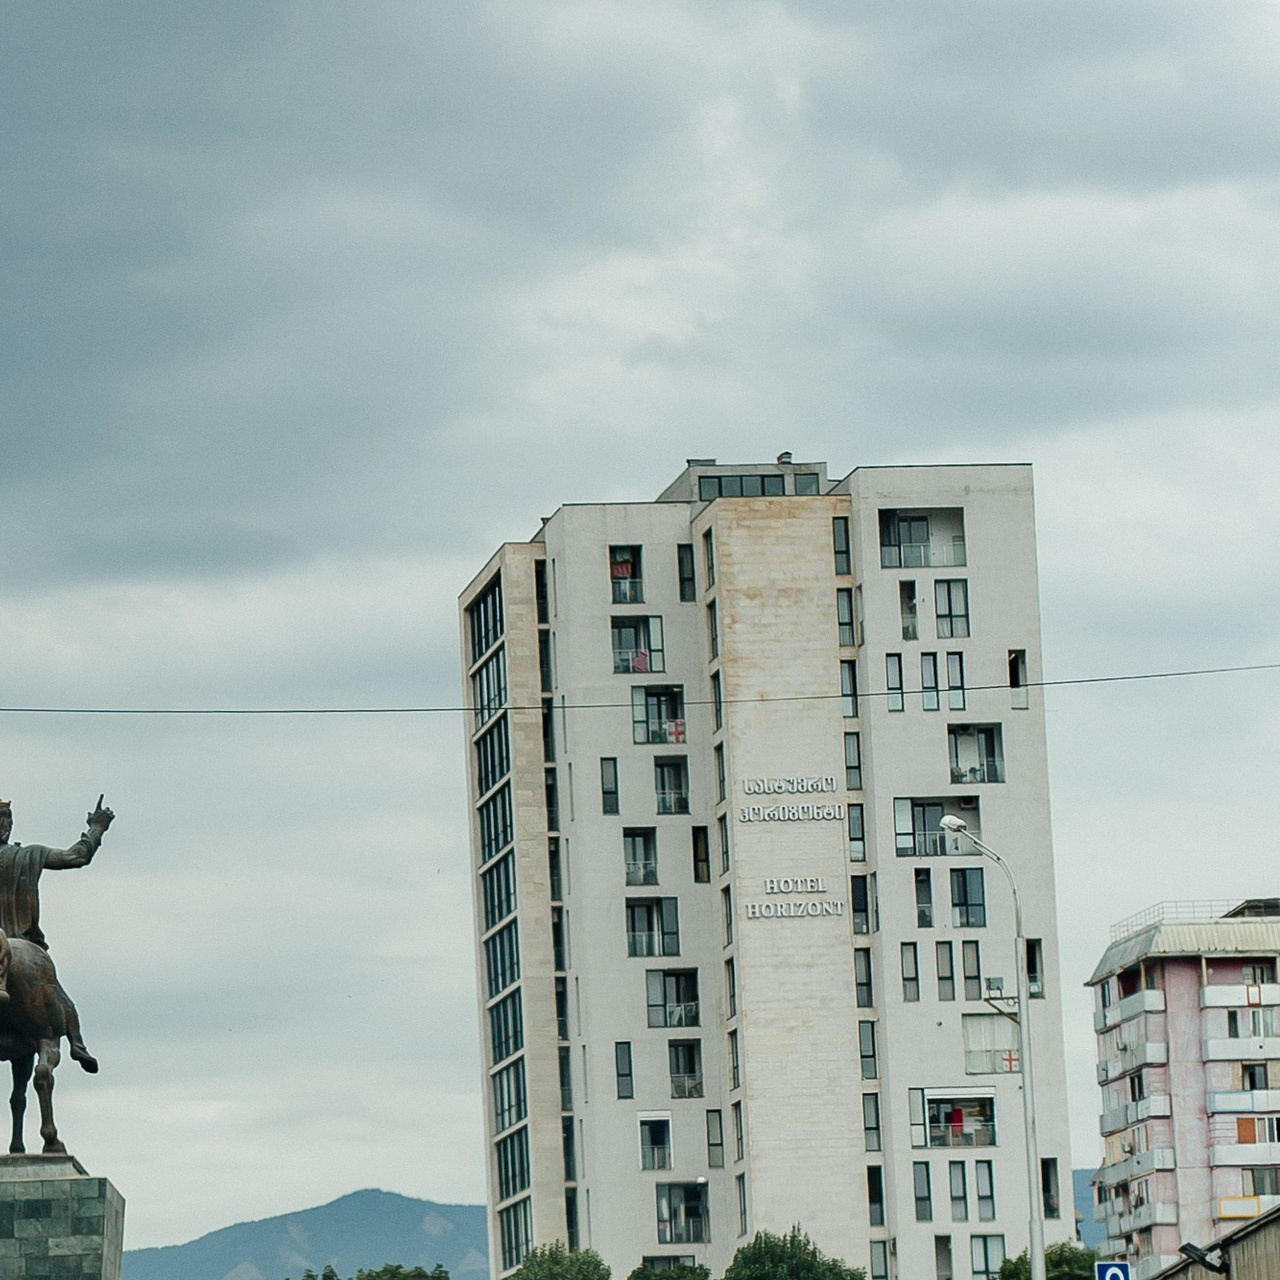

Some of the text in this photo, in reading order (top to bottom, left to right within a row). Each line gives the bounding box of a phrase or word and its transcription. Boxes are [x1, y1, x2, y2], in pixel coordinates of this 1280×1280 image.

[742, 776, 837, 795] სასტუმრო
[739, 802, 845, 823] ჰორიზონტი
[765, 877, 827, 894] HOTEL
[746, 901, 844, 919] HORIZONT
